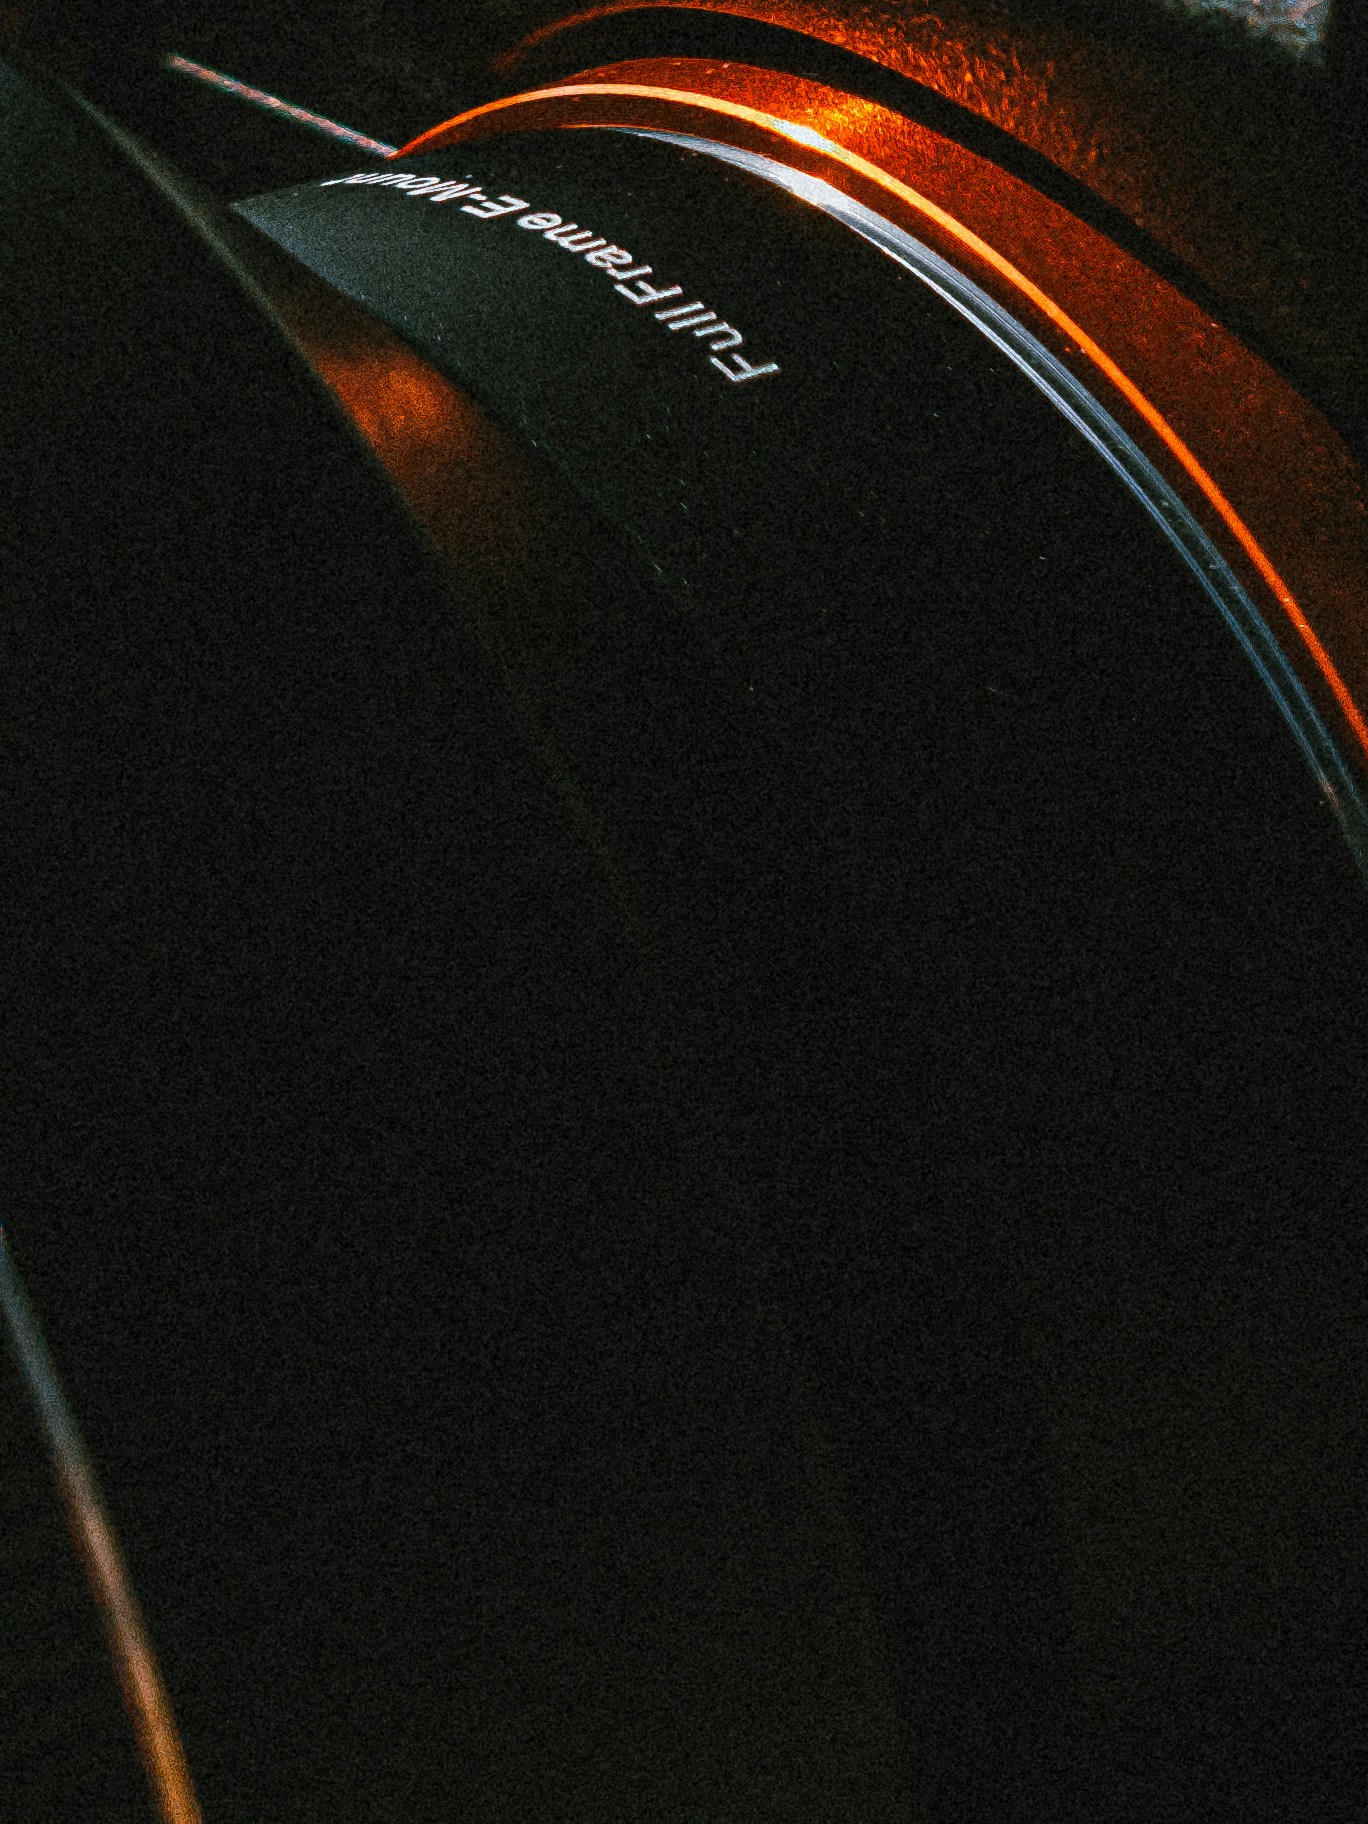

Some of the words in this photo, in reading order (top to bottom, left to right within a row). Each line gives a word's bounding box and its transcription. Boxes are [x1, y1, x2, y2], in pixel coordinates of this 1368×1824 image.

[320, 173, 531, 219] E-Mount
[516, 211, 684, 306] Frame
[653, 301, 782, 384] Full
